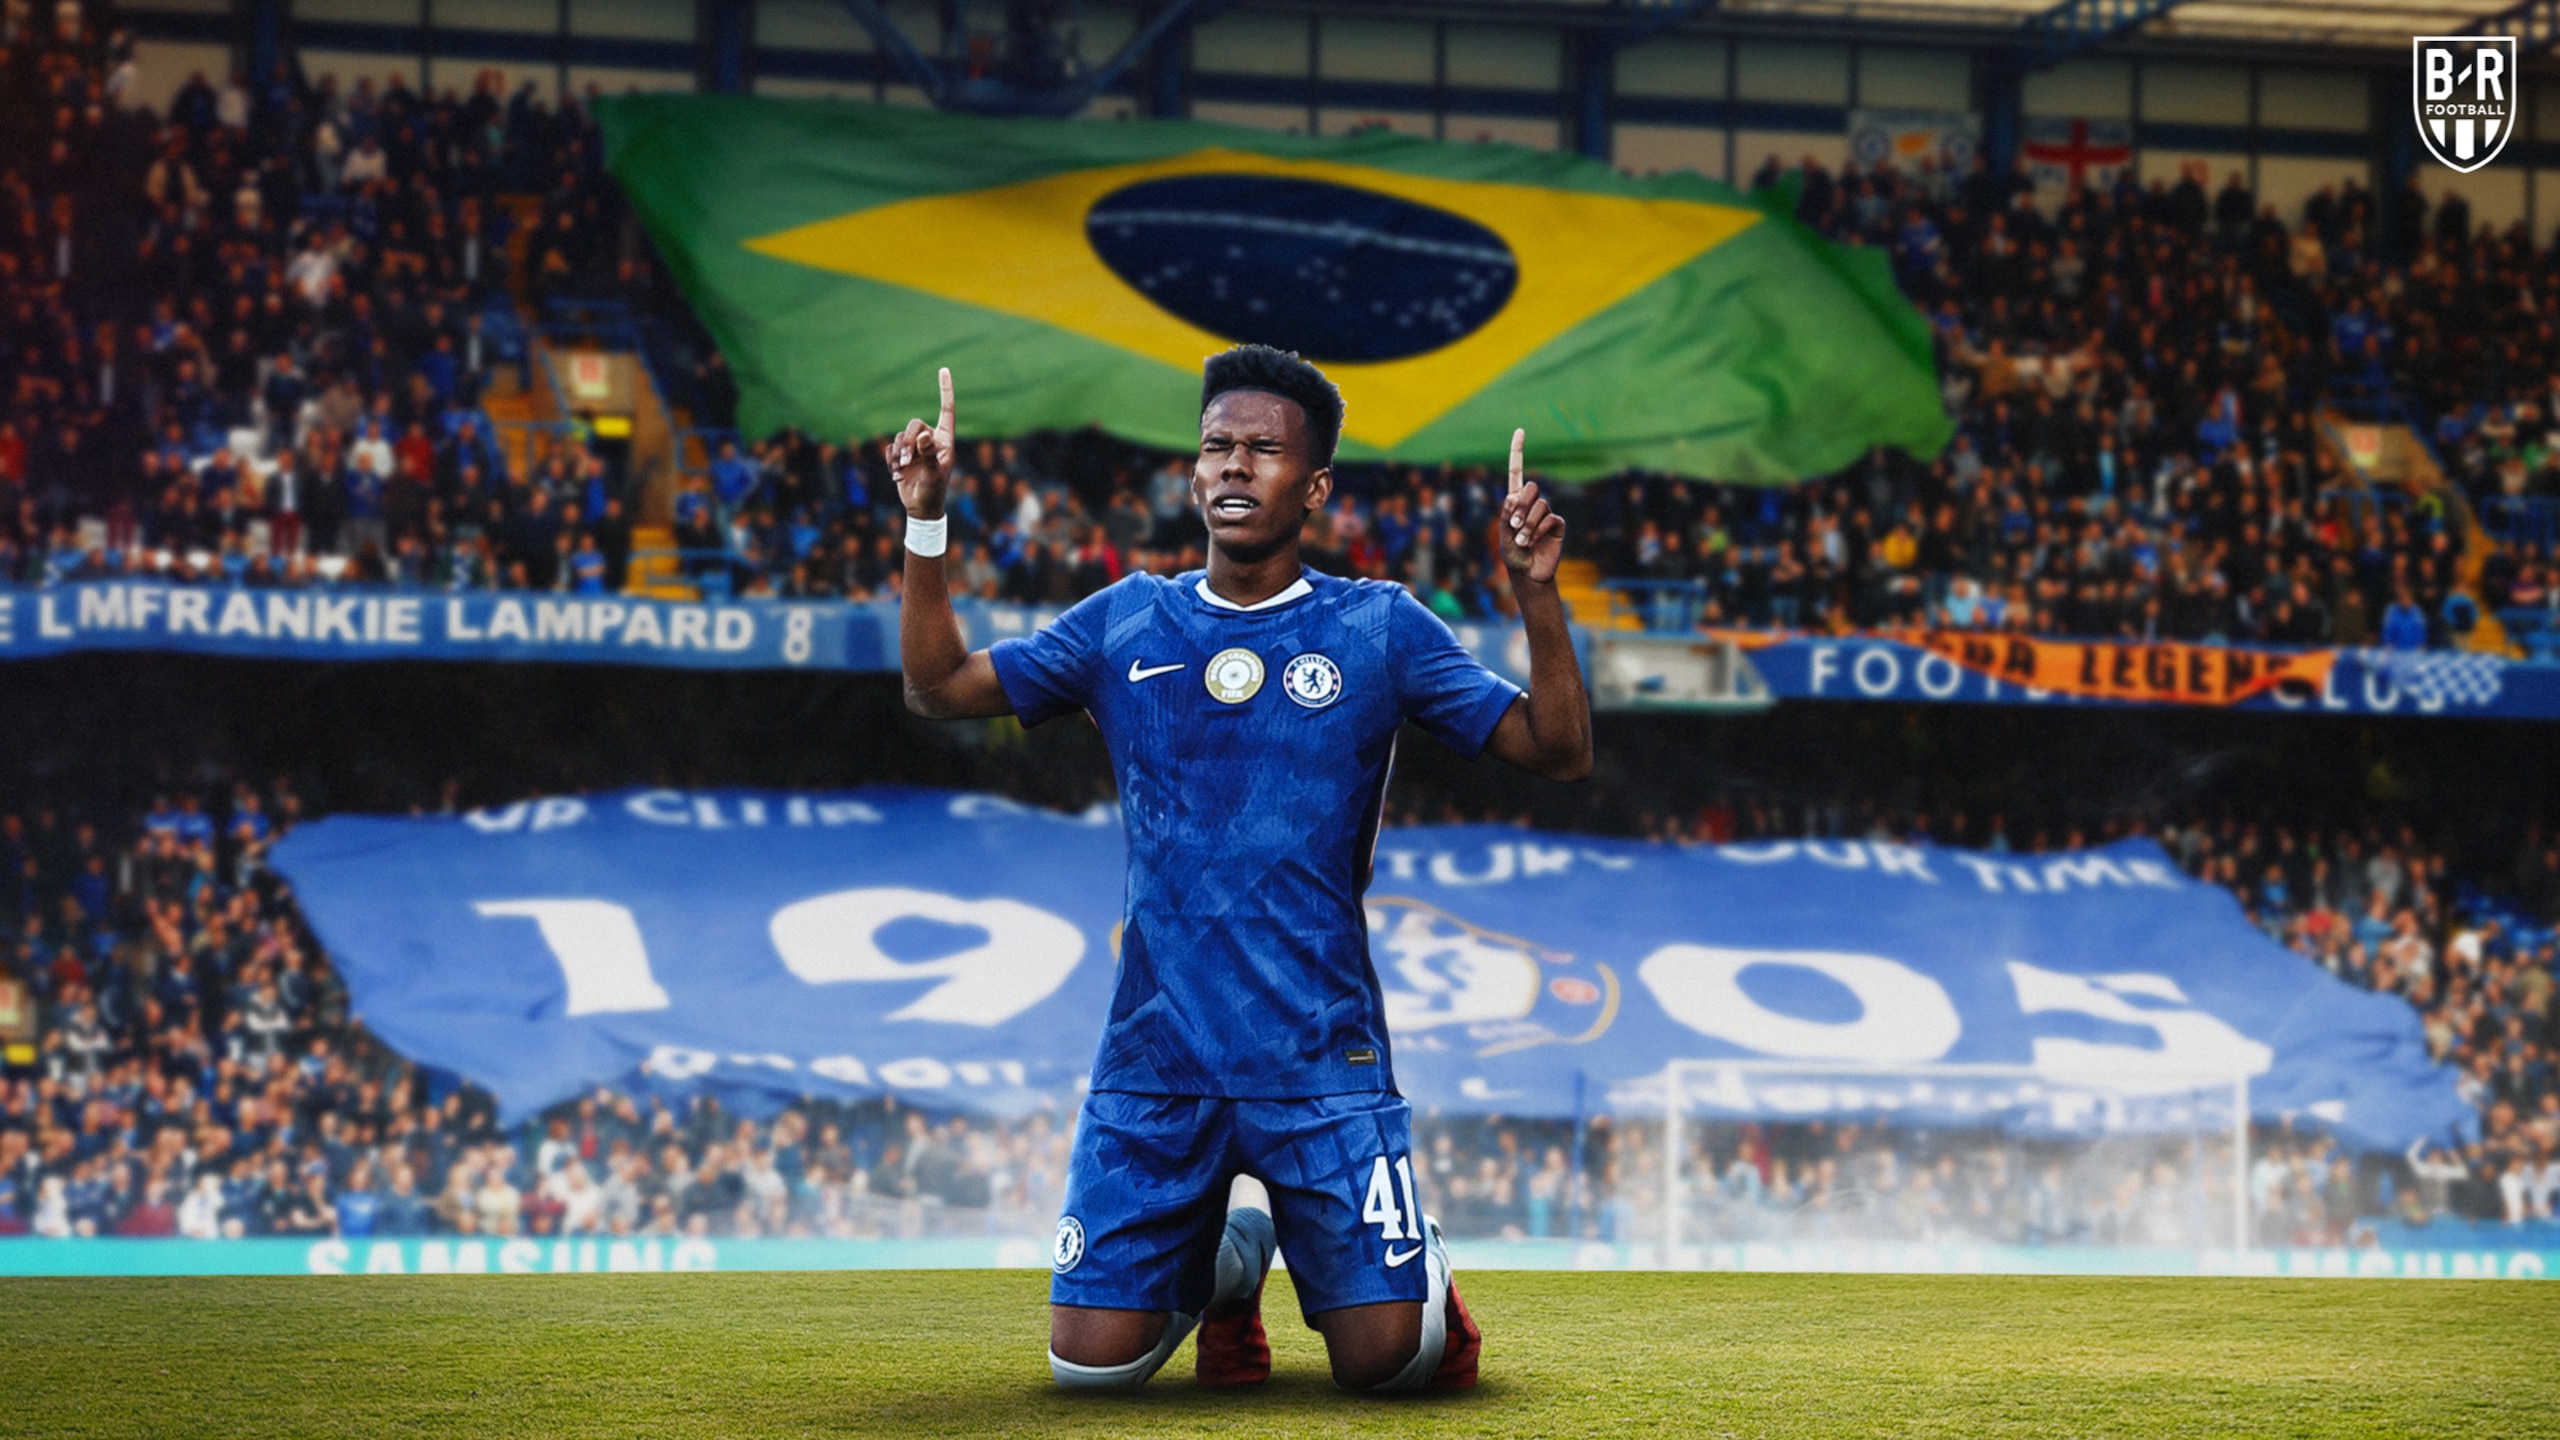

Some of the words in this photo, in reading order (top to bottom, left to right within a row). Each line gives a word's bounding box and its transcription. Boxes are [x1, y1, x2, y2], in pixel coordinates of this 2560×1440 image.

[446, 598, 756, 652] LAMPARD
[782, 606, 813, 664] 8
[1361, 1154, 1422, 1241] 41
[306, 1239, 719, 1275] SAMSUNG
